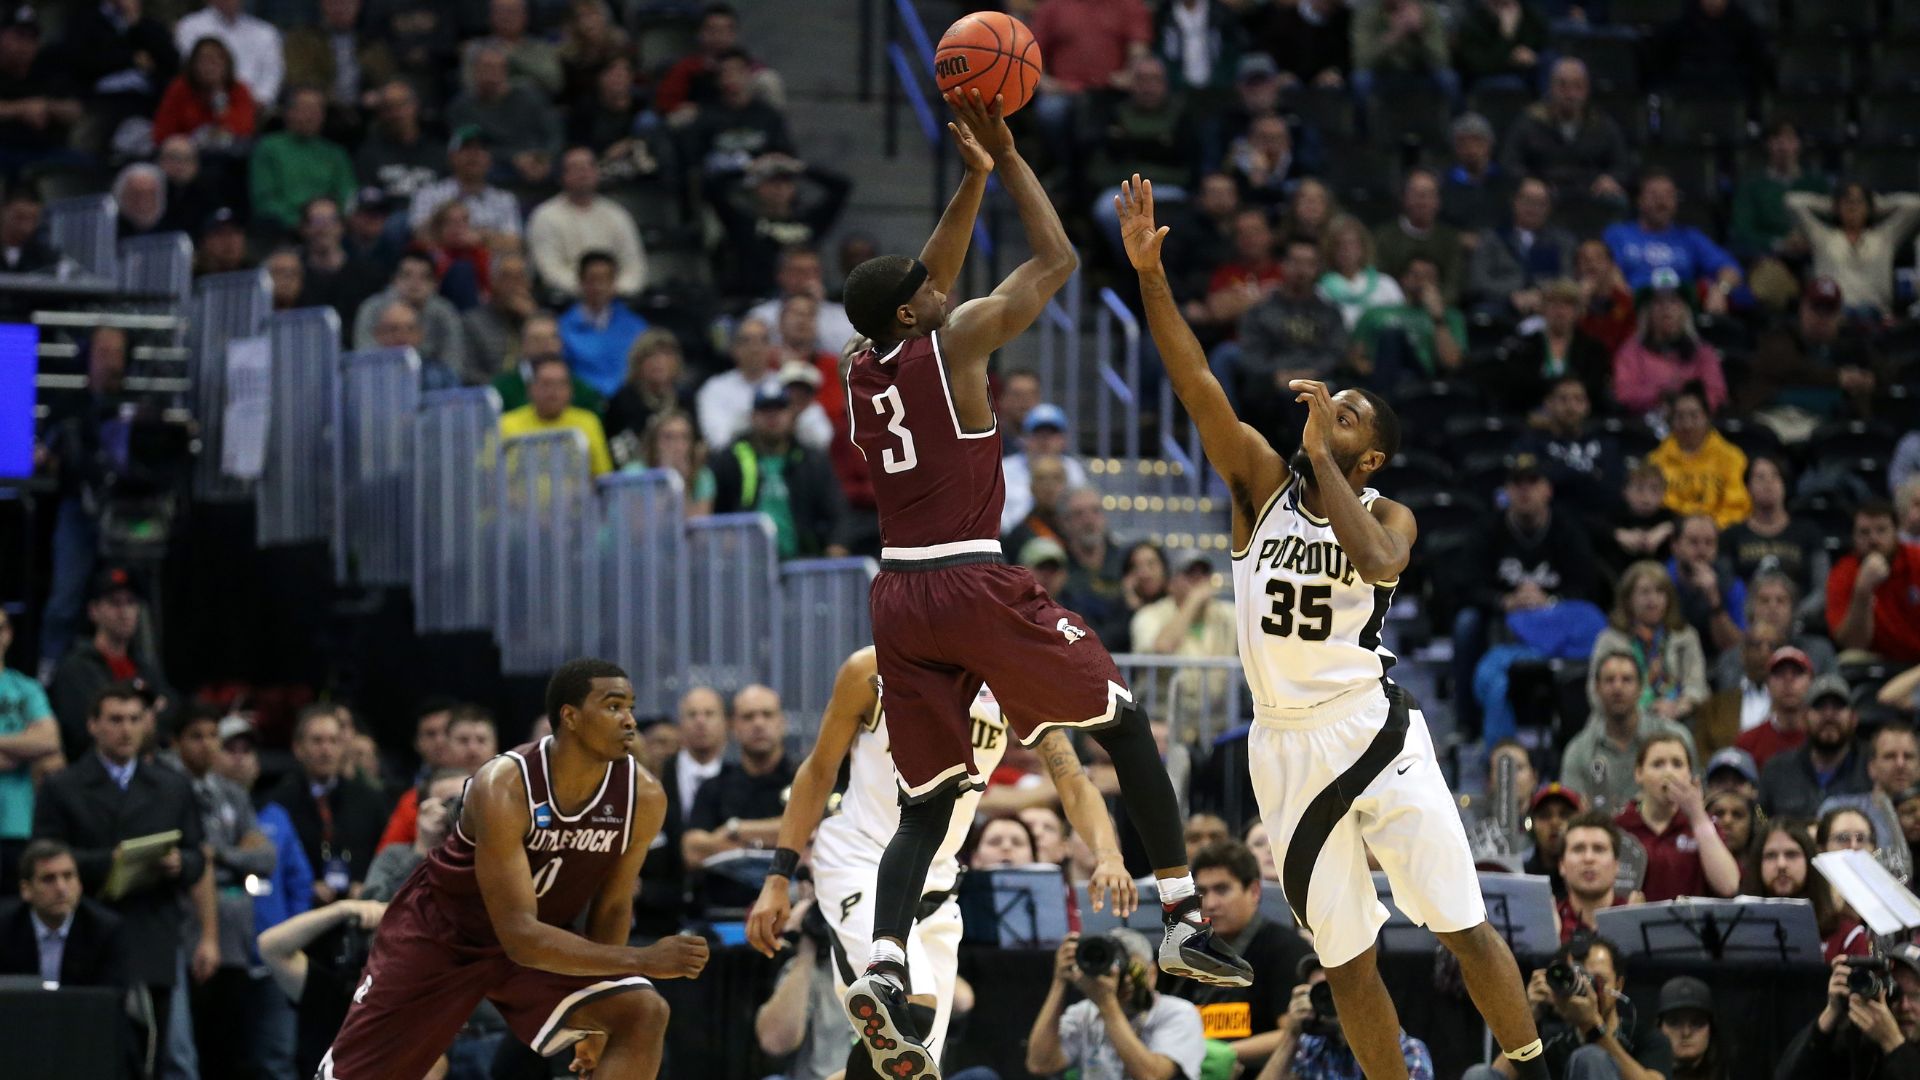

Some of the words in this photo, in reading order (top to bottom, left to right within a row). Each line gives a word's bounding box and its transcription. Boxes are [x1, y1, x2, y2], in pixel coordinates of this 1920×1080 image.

[871, 384, 918, 474] 3
[1255, 535, 1355, 587] PURDUE
[1260, 578, 1333, 641] 35
[840, 891, 862, 924] P
